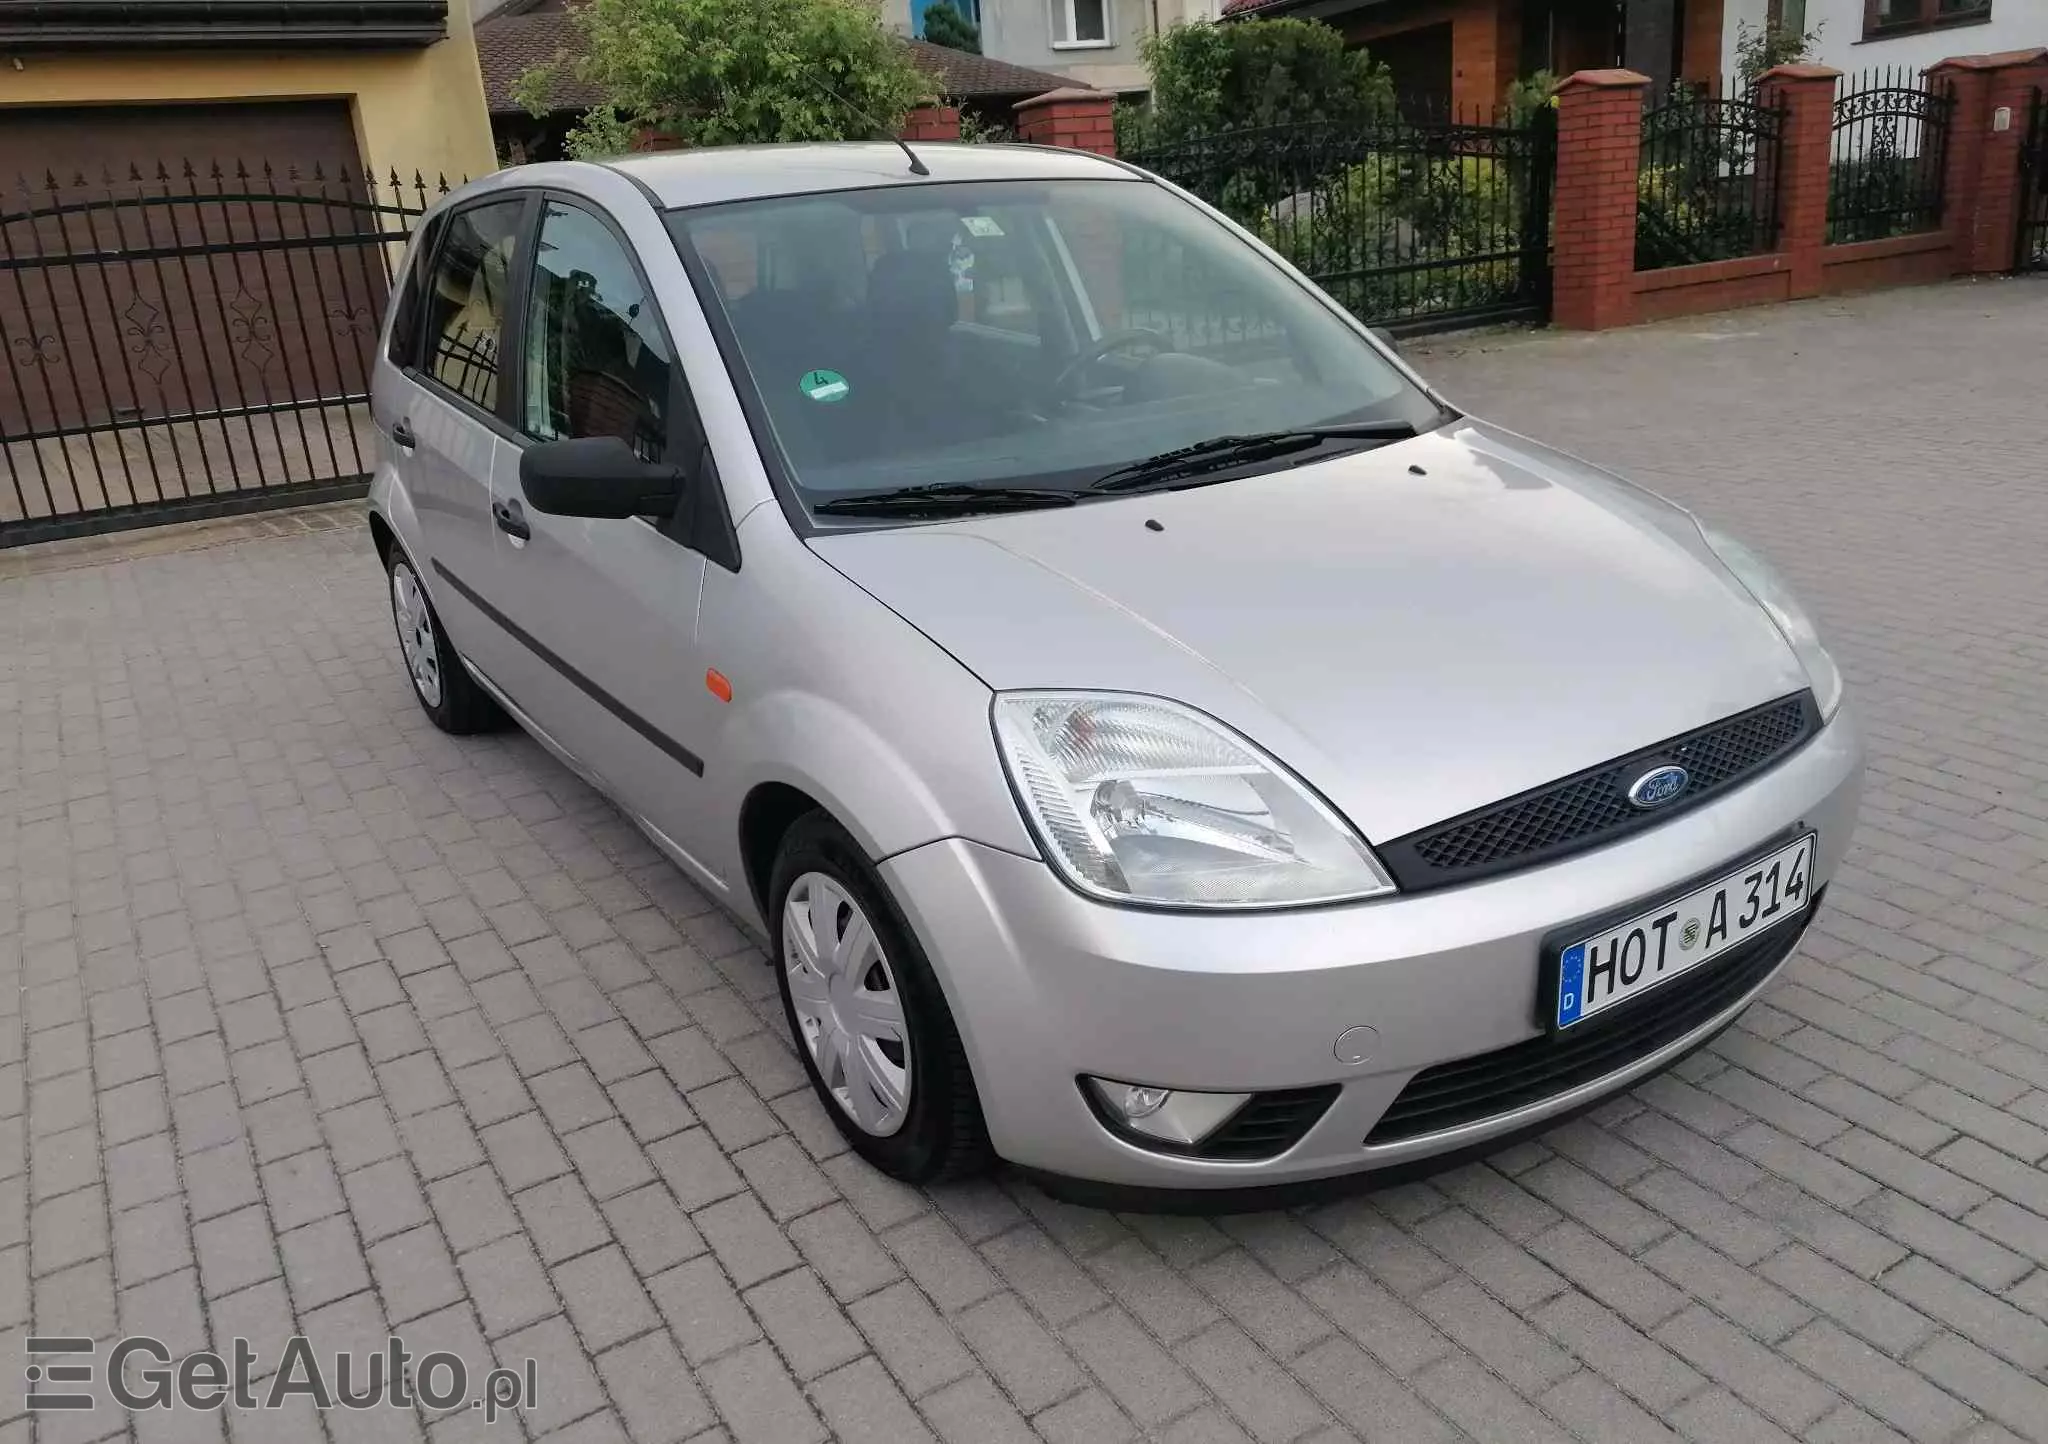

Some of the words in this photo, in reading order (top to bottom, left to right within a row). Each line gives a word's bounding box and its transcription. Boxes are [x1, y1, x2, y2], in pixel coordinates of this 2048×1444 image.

[1645, 772, 1680, 801] Ford
[1587, 911, 1678, 1003] HOT
[1705, 889, 1728, 949] A
[1738, 847, 1805, 929] 314
[1562, 992, 1575, 1011] D
